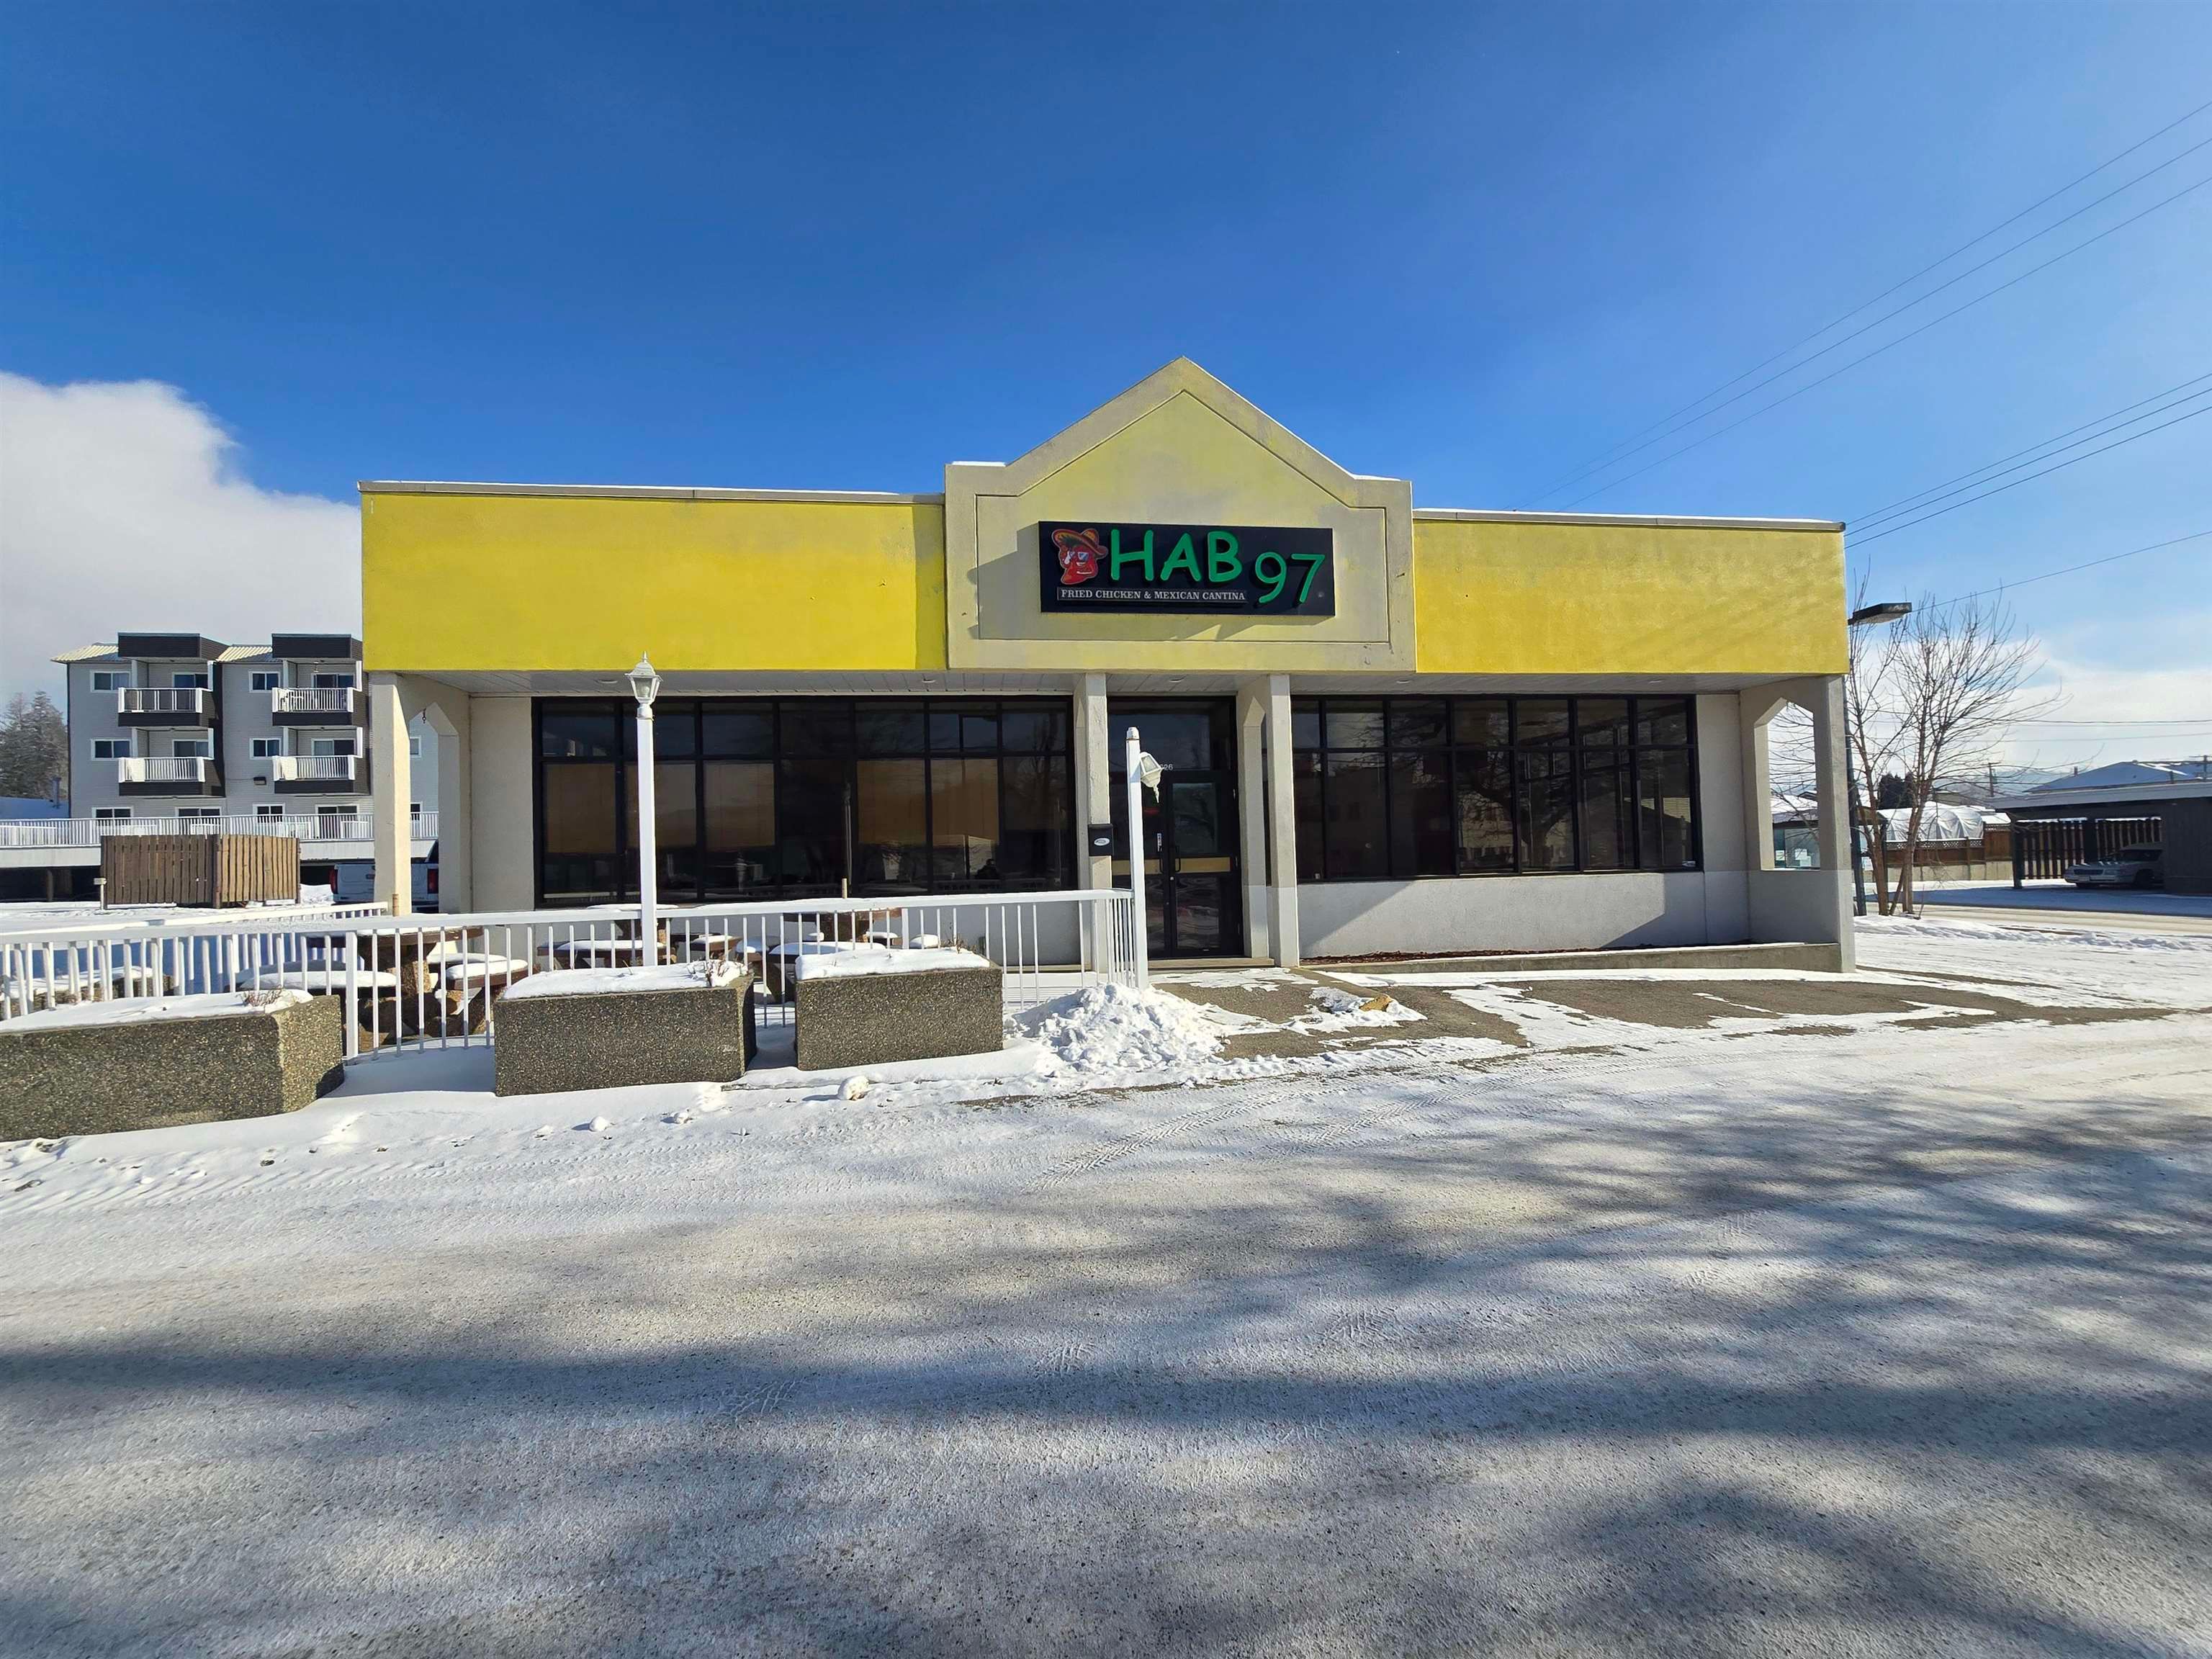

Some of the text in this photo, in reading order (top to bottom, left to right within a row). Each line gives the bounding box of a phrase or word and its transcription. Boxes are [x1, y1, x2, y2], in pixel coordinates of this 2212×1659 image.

[1110, 529, 1326, 604] HAB 97
[1061, 589, 1093, 598] FRIED
[1095, 590, 1141, 599] CHICKEN
[1143, 590, 1152, 599] &
[1154, 591, 1200, 600] MEXICAN
